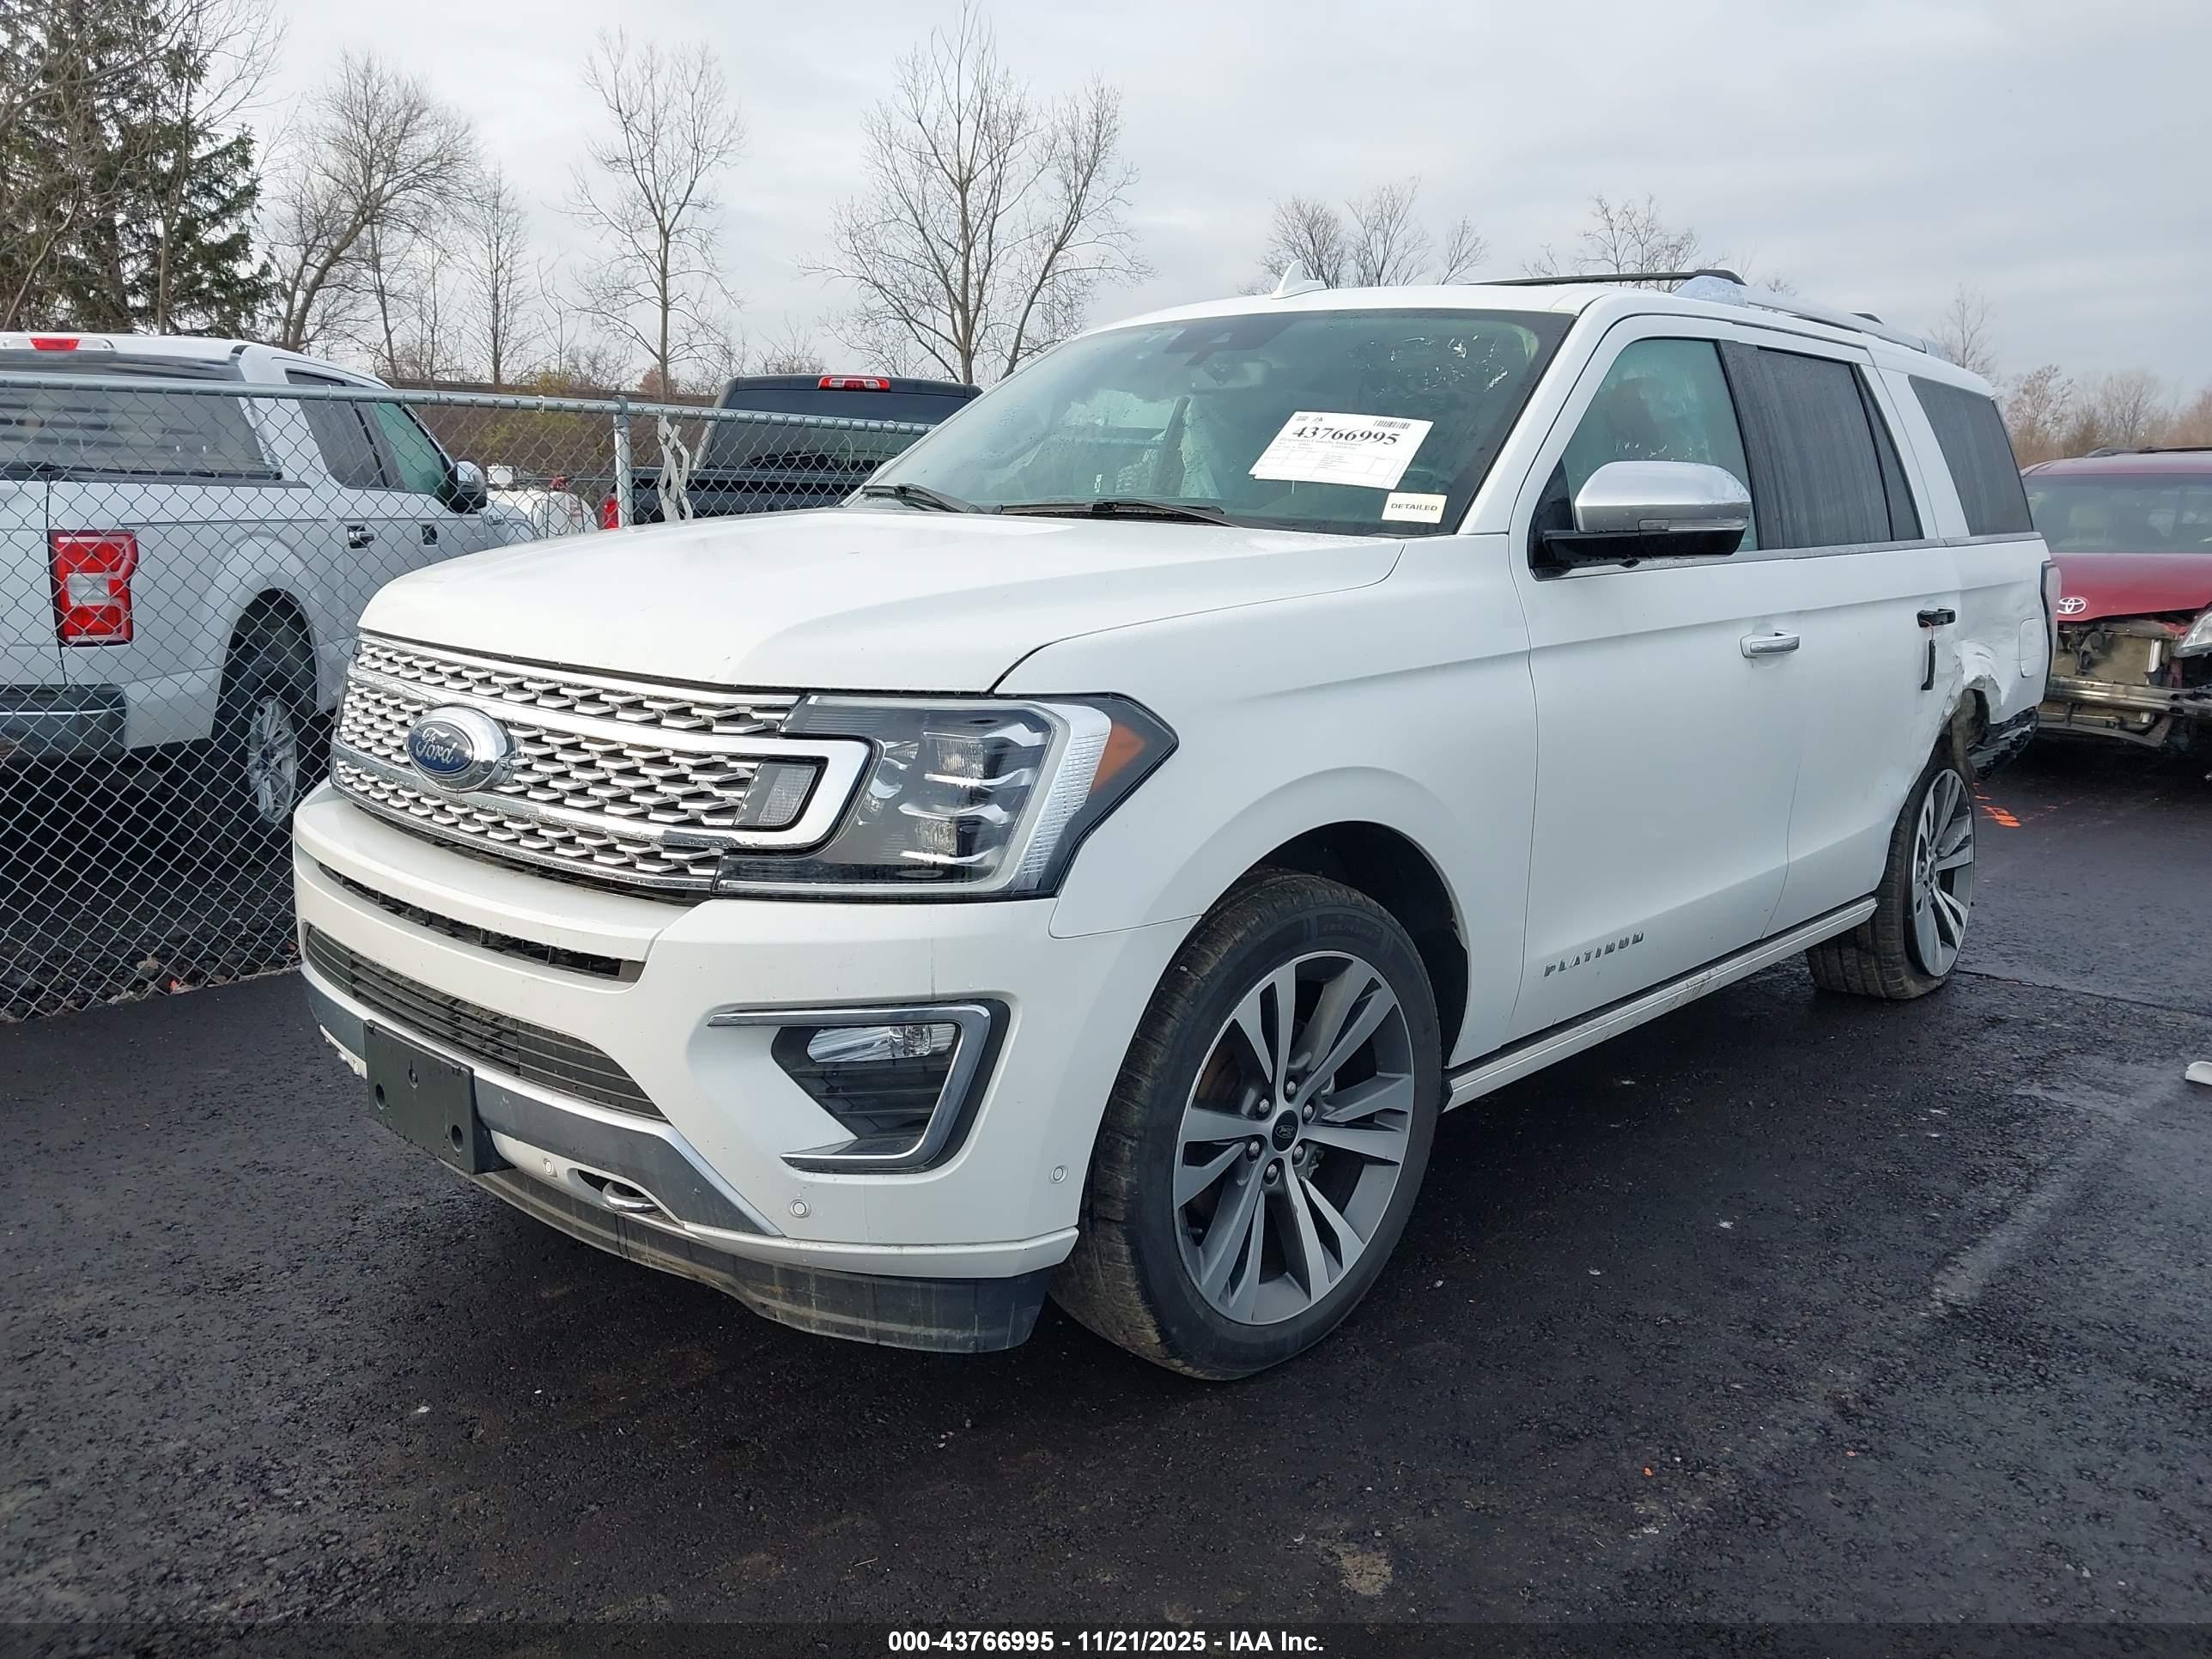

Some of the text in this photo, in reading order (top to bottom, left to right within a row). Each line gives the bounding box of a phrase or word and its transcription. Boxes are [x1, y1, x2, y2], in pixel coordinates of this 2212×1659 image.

[1292, 425, 1401, 446] 43766995
[1390, 502, 1438, 512] DETAILED
[416, 727, 458, 765] Ford
[1544, 931, 1644, 977] PLATINUM
